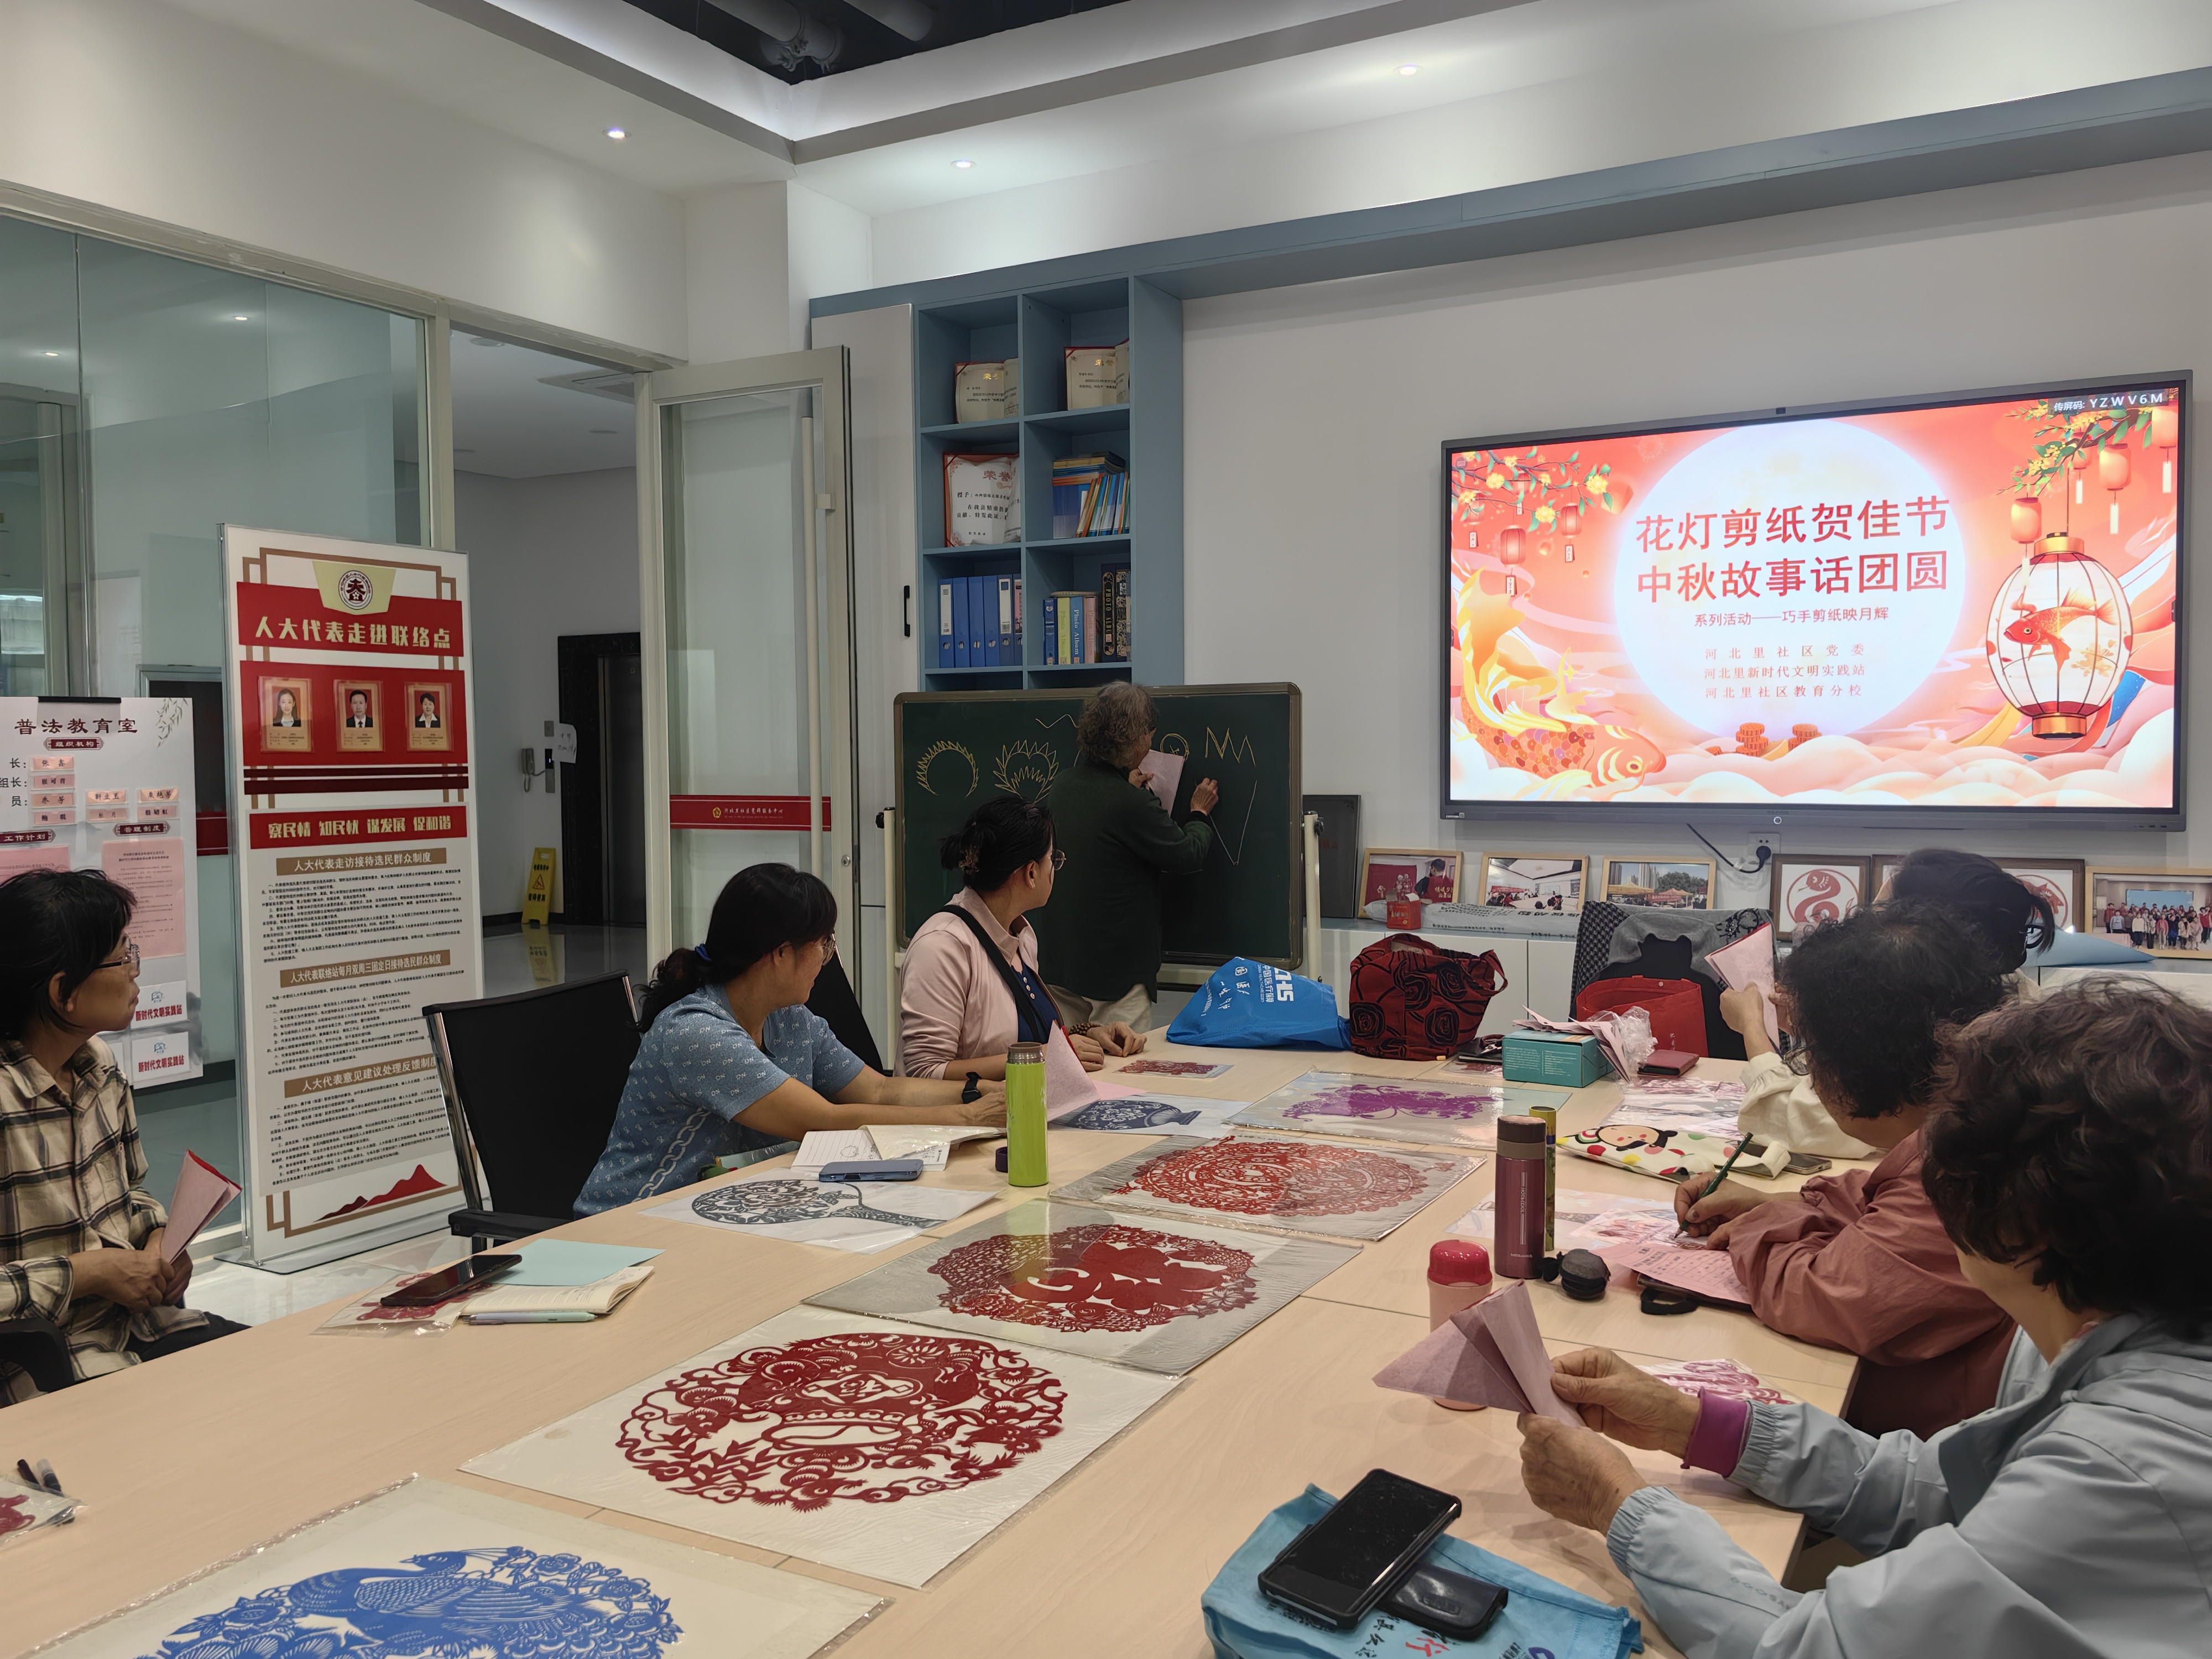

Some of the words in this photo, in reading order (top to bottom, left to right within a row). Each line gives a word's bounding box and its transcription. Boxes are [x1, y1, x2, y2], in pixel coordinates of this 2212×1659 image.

[2054, 400, 2085, 411] 传屏码:
[1636, 495, 1950, 553] 花灯剪纸贺佳节
[1637, 551, 1947, 603] 中秋故事话团圆
[255, 616, 451, 648] 人大代表走进联络点
[1704, 665, 1865, 680] 河北里新时代文明实践站
[1705, 684, 1862, 698] 河北里社区教育分校
[14, 718, 138, 735] 普法教育室
[124, 825, 161, 833] 管理制度
[268, 821, 311, 838] 察民情
[414, 815, 451, 831] 促和谐
[4, 833, 45, 842] 工作计划
[294, 852, 432, 872] 人大代表走访接待选民群众制度
[135, 1005, 182, 1021] 新时代文明实践站
[138, 1055, 184, 1072] 新时代文明实践站
